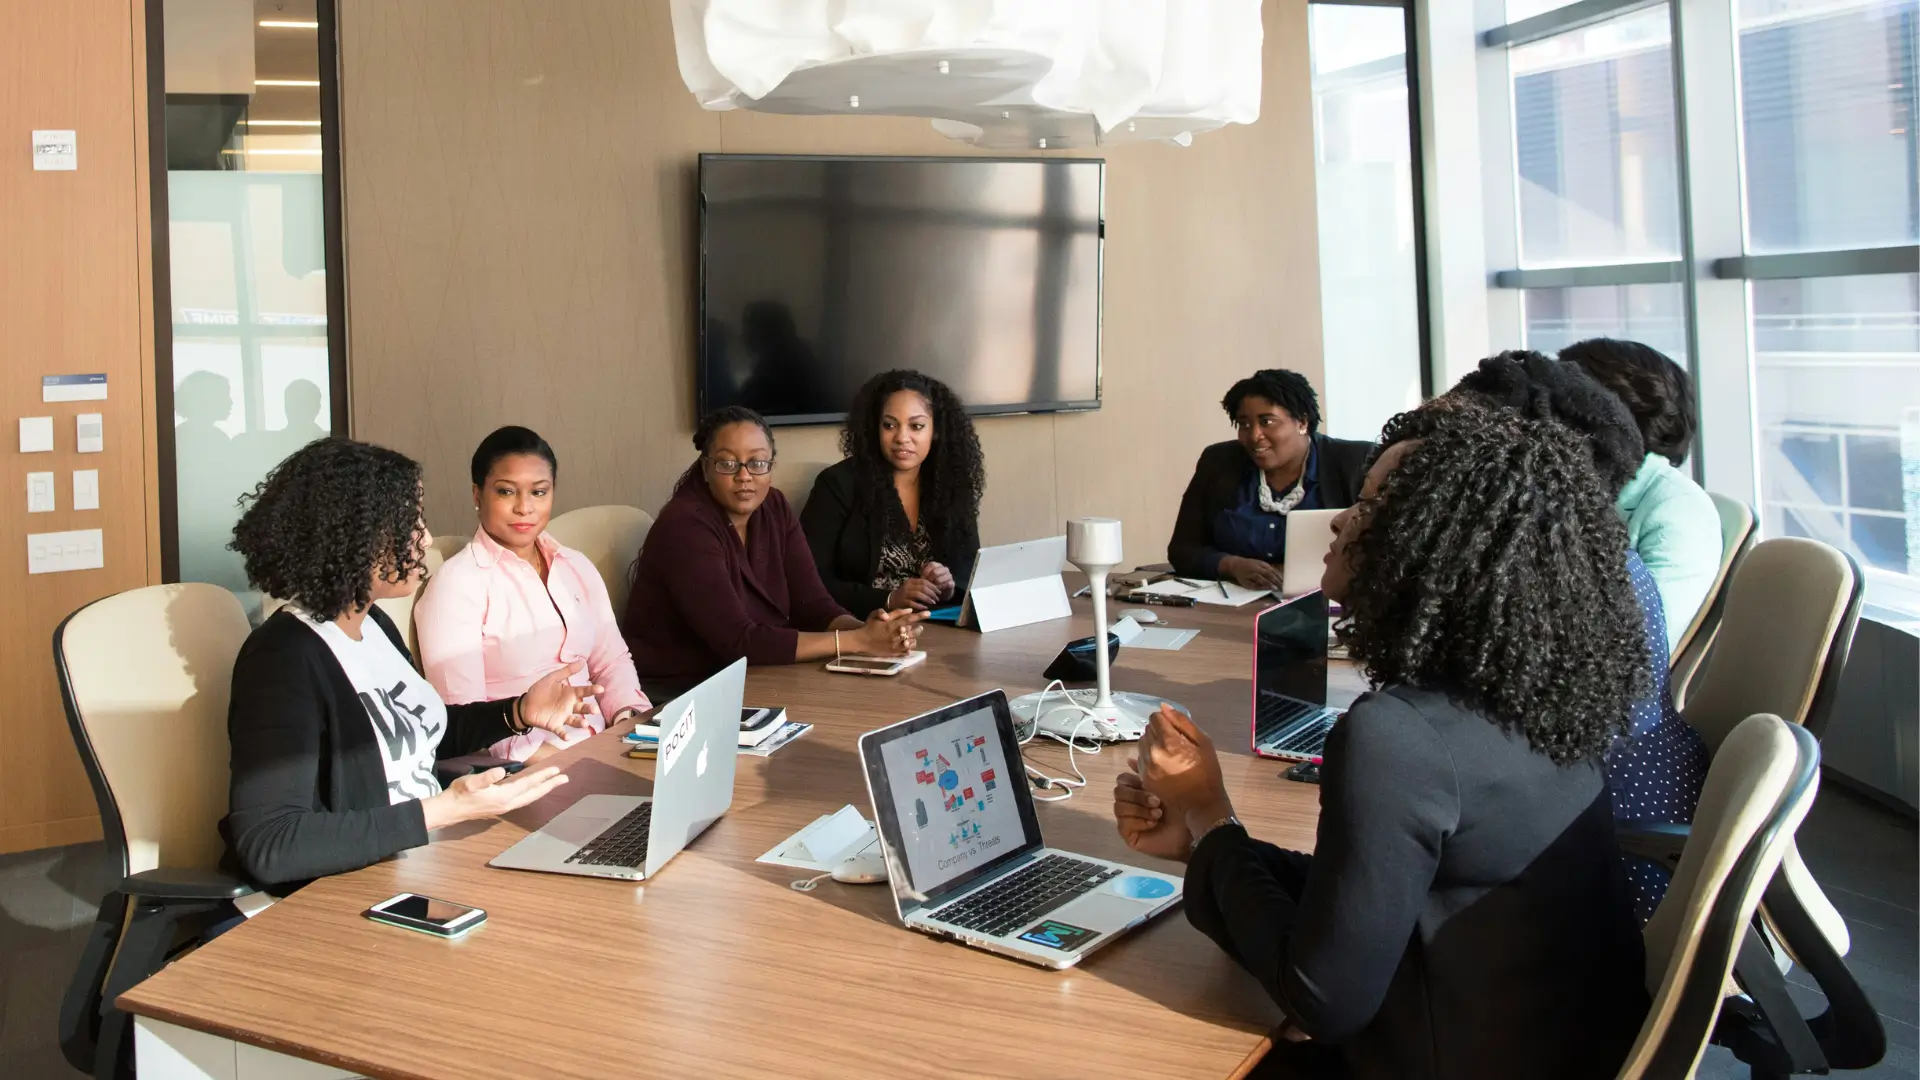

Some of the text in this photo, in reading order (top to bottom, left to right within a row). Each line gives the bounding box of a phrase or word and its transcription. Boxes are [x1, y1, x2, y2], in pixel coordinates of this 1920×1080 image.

[664, 708, 694, 761] POCIT
[937, 851, 968, 871] Company
[978, 835, 1000, 851] Threats
